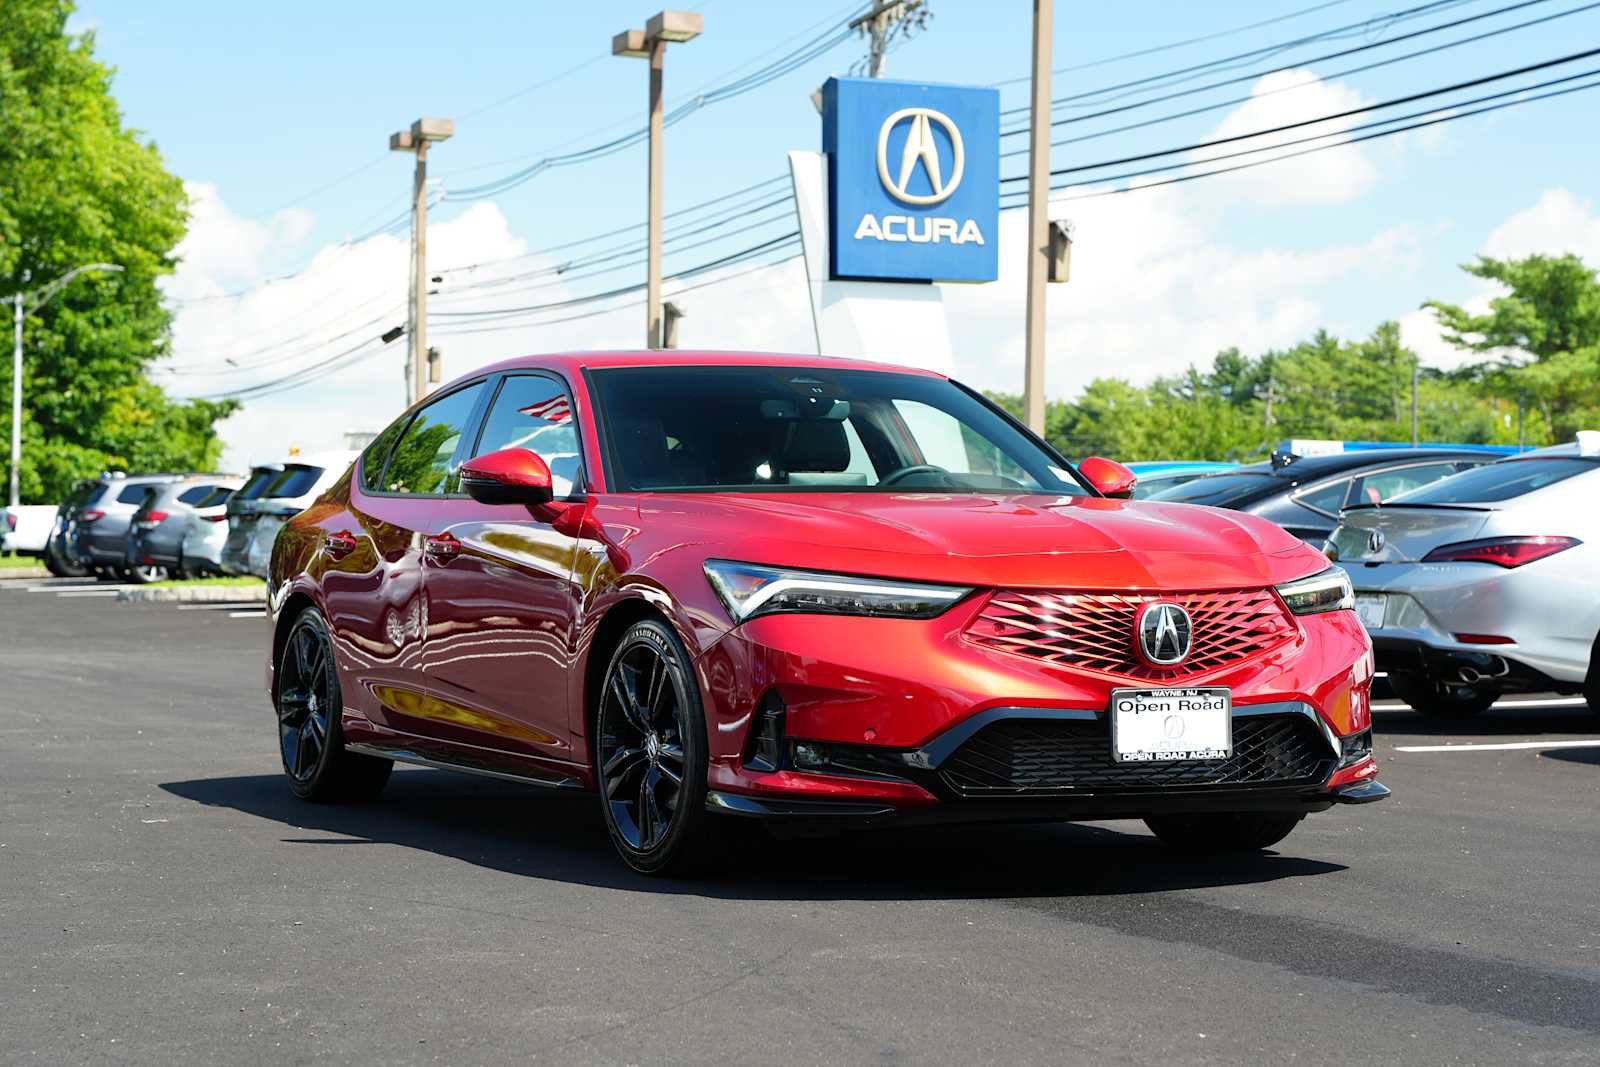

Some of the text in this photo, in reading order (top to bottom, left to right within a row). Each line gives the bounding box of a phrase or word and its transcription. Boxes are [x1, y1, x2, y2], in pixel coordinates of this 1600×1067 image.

[854, 213, 985, 246] ACURA
[1119, 699, 1224, 714] Open Road
[1122, 750, 1227, 760] OPEN ROAD ACURA
